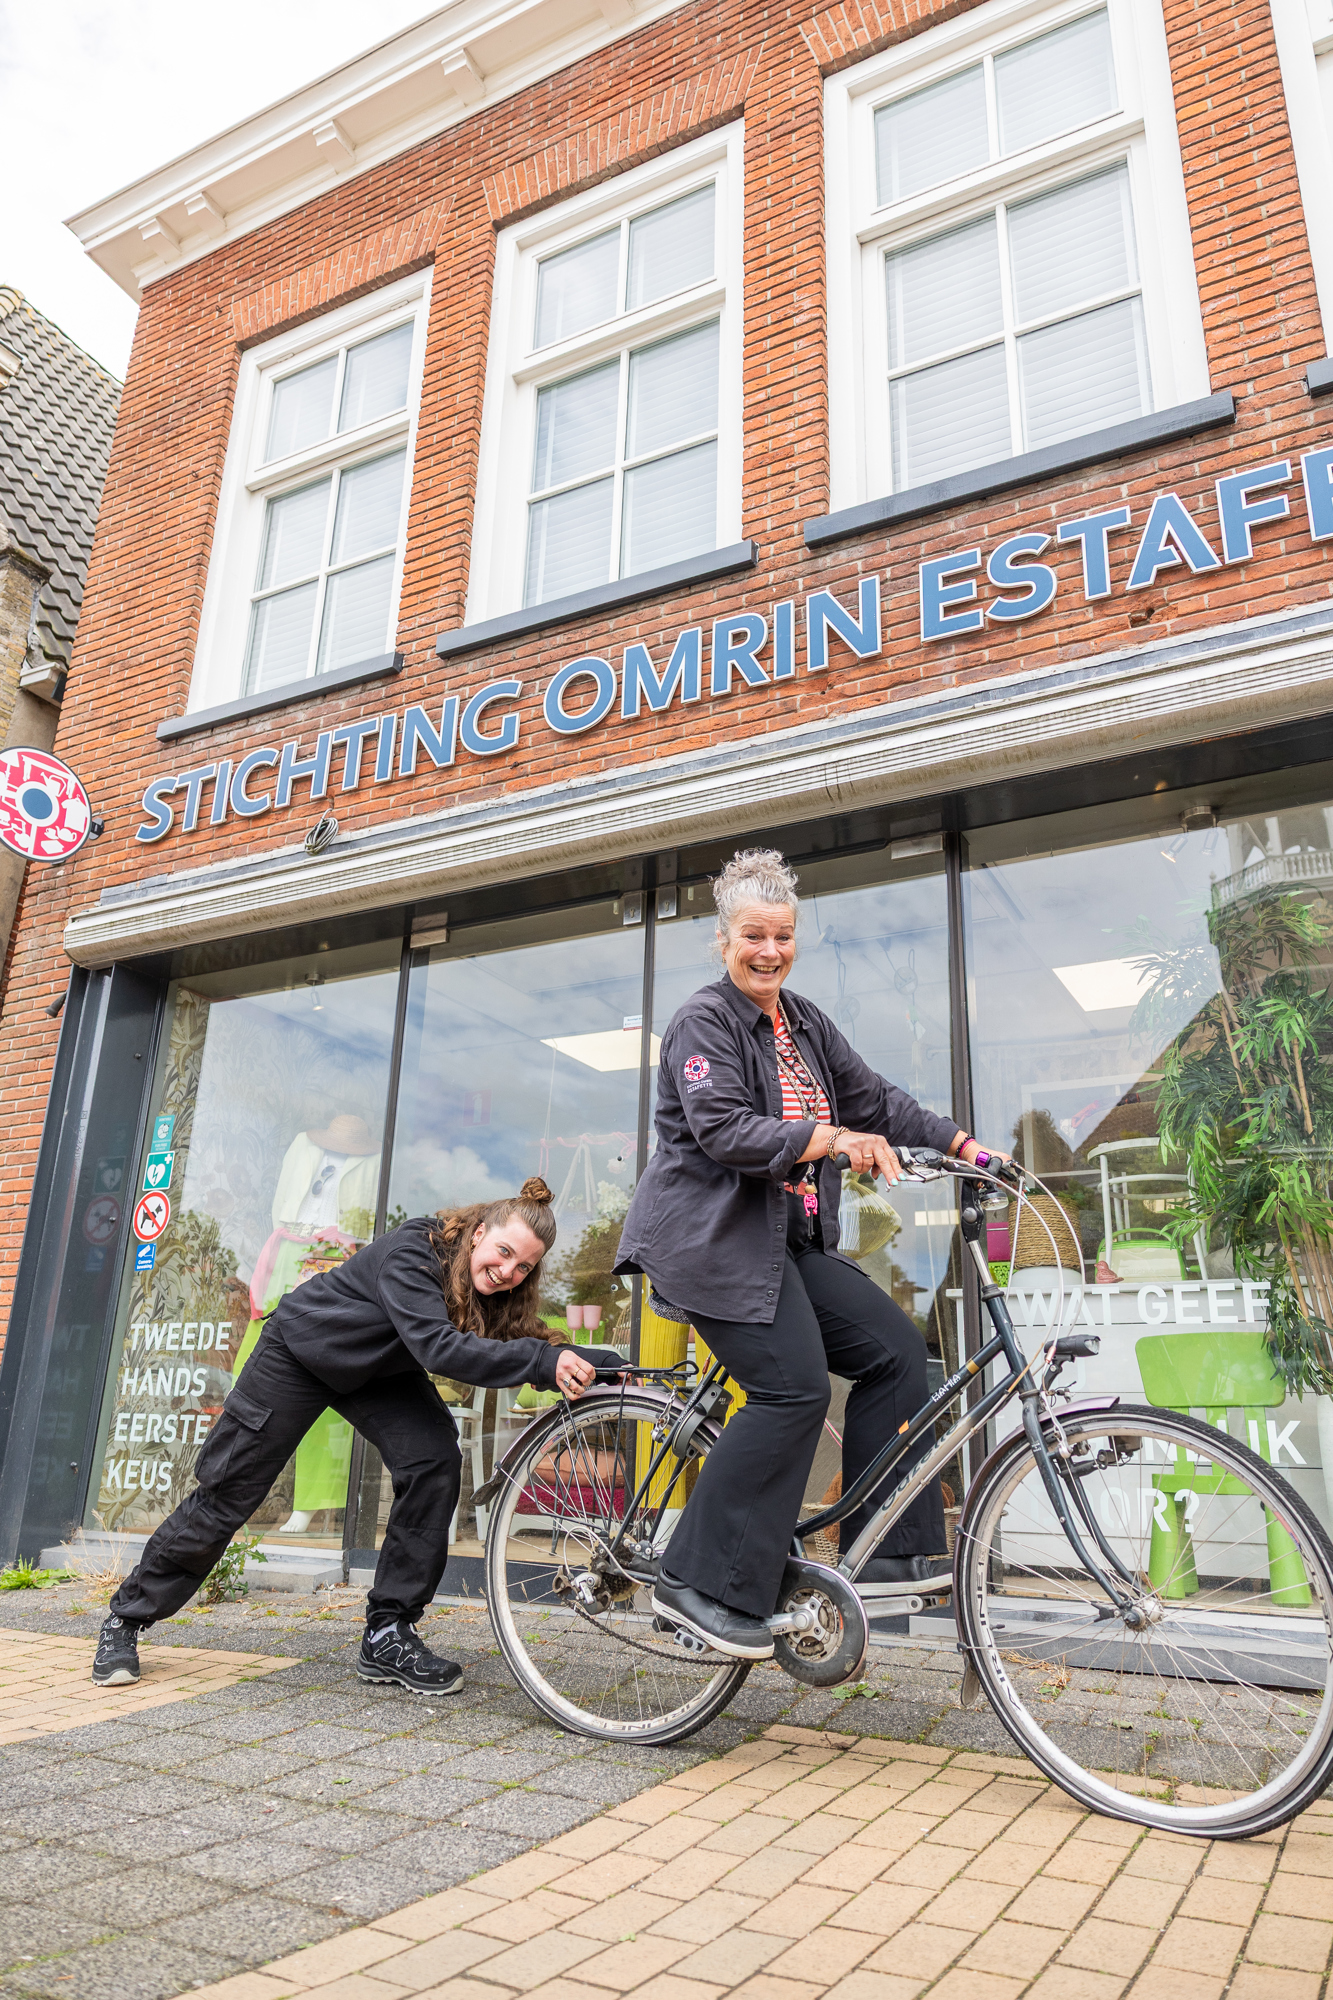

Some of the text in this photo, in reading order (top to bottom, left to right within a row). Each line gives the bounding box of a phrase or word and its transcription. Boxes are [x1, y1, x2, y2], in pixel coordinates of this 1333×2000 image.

[135, 680, 522, 844] STICHTING
[543, 575, 883, 735] OMRIN
[1016, 1281, 1271, 1327] WAT GEEF
[130, 1321, 233, 1351] TWEEDE
[121, 1368, 208, 1397] HANDS
[930, 1373, 961, 1403] BAHIA
[113, 1413, 211, 1445] EERSTE
[106, 1458, 174, 1492] KEUS
